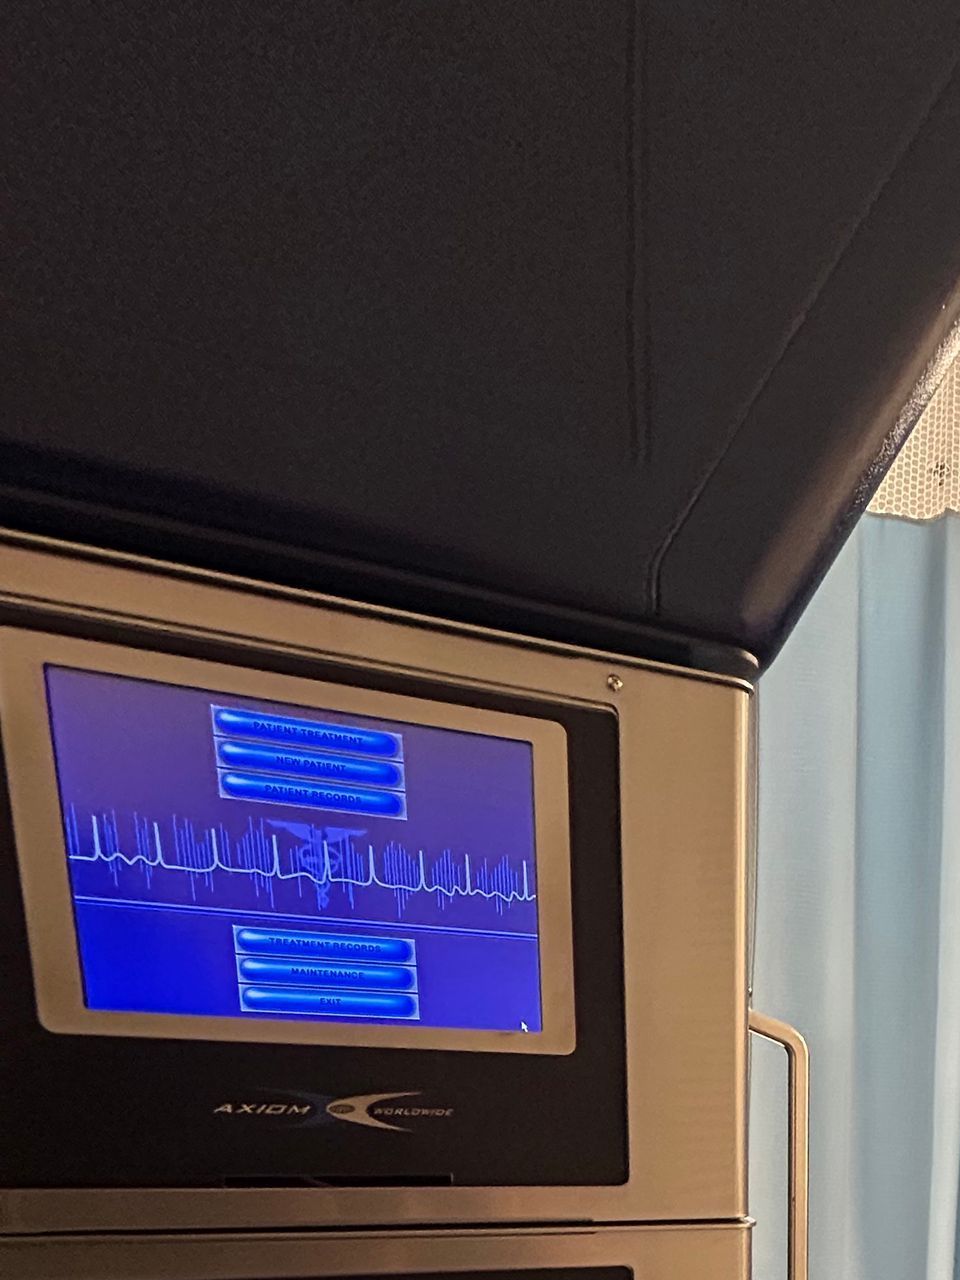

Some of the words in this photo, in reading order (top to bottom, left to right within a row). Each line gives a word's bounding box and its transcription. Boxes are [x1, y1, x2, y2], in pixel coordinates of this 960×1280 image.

[253, 721, 298, 735] PATIENT
[300, 728, 363, 746] TREATMENT
[276, 755, 300, 767] NEW
[303, 759, 346, 773] PATIENT
[264, 784, 310, 797] PATIENT
[311, 790, 362, 803] RECORDS
[268, 937, 330, 950] TREATMENT
[333, 942, 382, 953] RECORDS
[290, 967, 365, 980] MAINTENANCE
[319, 997, 342, 1006] EXIT
[213, 1103, 311, 1115] AXIOM
[373, 1106, 454, 1117] WORLDWIDE
